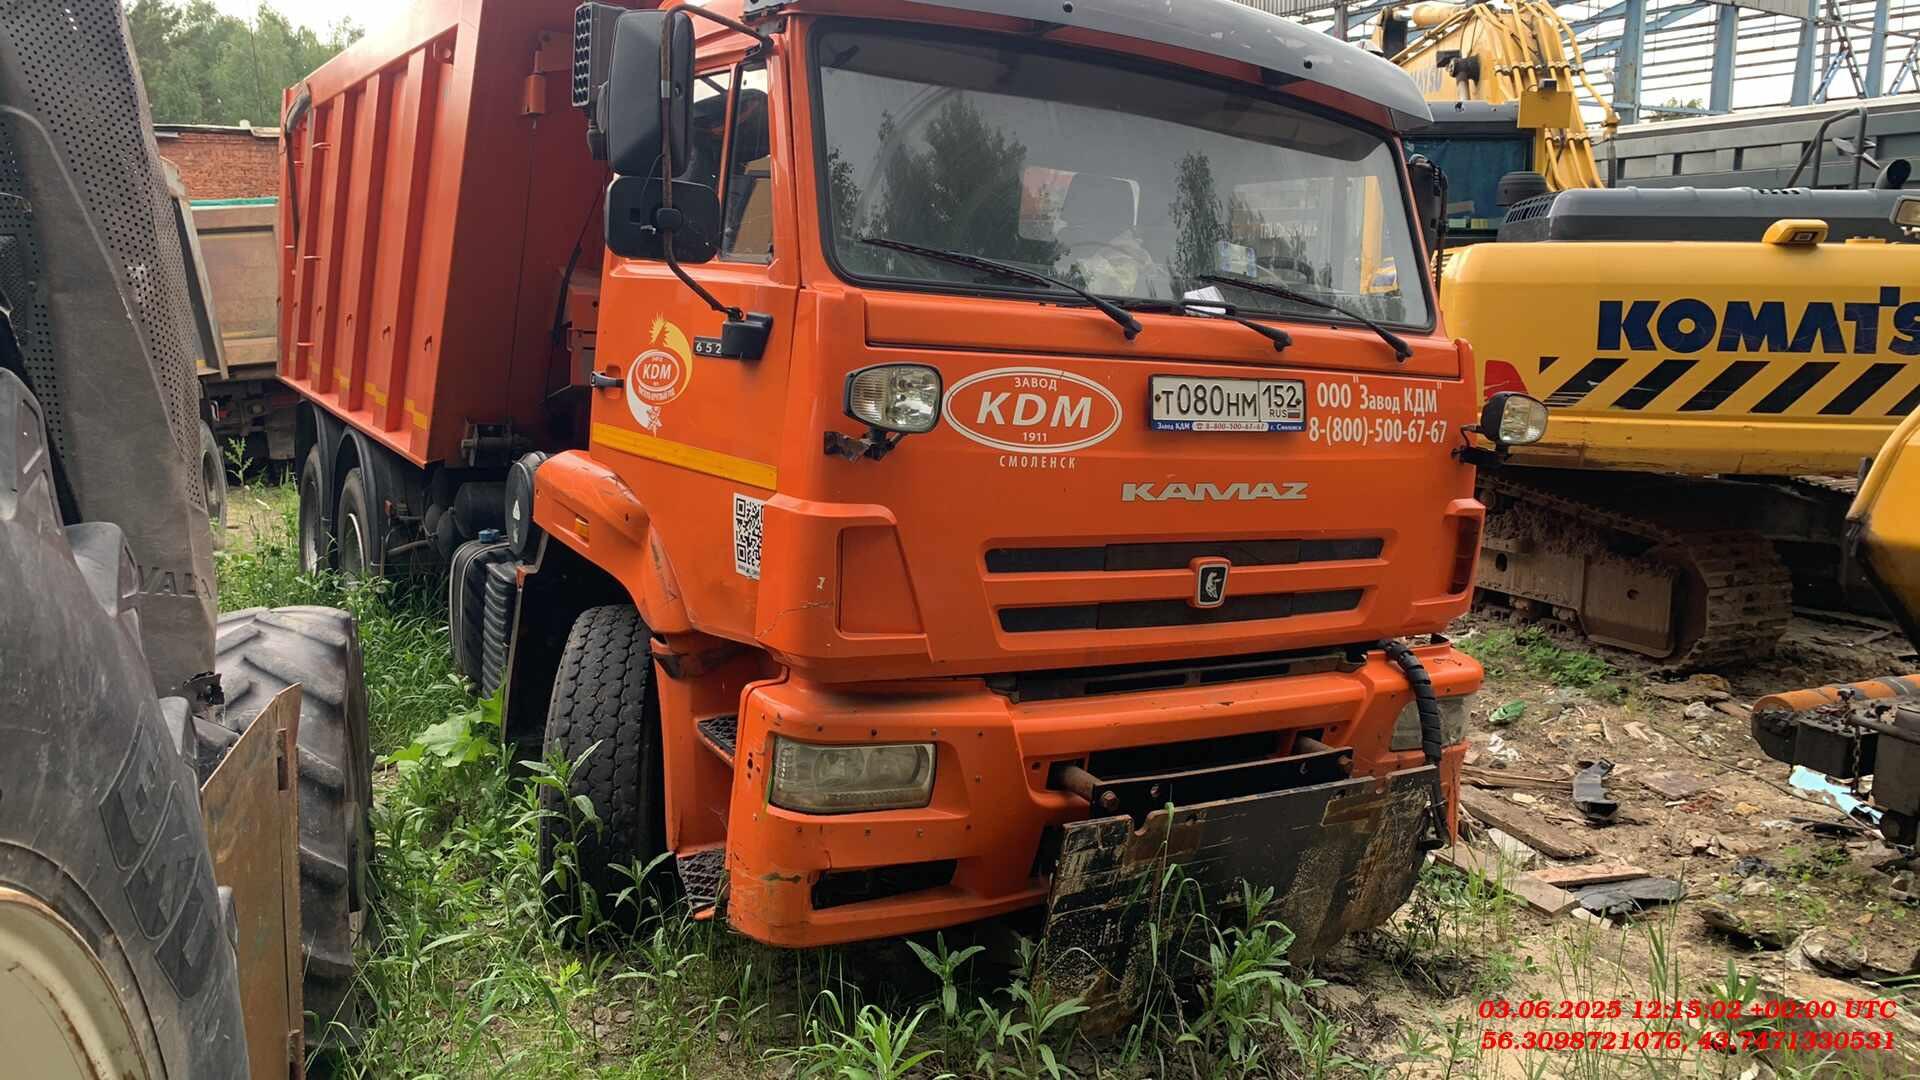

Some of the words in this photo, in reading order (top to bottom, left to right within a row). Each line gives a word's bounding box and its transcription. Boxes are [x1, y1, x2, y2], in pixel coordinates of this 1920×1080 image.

[1596, 286, 1920, 356] KOMATS
[695, 342, 722, 354] 652
[642, 364, 672, 380] KDM
[1014, 377, 1057, 391] ЗАВОД
[1262, 385, 1298, 408] 152
[1317, 382, 1352, 408] ООО
[1353, 376, 1400, 414] "Завод
[1404, 382, 1442, 416] КДМ"
[976, 391, 1093, 429] KDM
[1269, 408, 1288, 418] RUS
[1023, 432, 1047, 442] 1911
[1309, 416, 1447, 446] 8-(800)-500-67-67
[999, 455, 1077, 469] СМОЛЕНСК
[1122, 482, 1309, 502] KAMAZ
